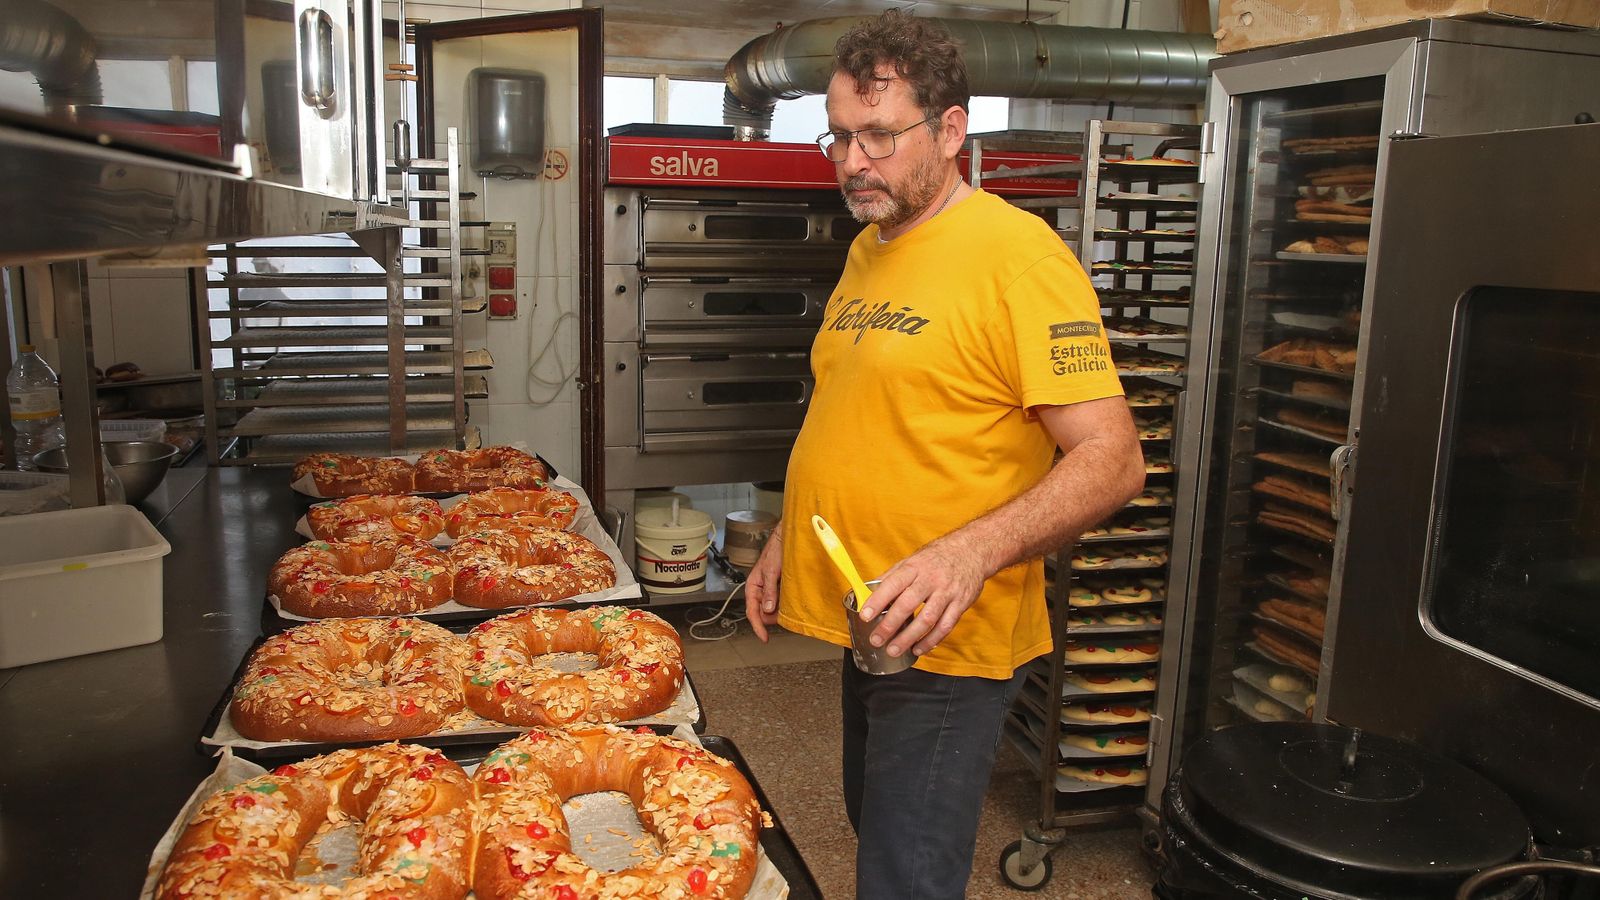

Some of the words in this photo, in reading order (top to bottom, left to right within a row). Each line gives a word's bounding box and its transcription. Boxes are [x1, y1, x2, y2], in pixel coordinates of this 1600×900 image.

[650, 151, 719, 176] salva
[828, 298, 930, 345] Tarifeña
[1050, 343, 1107, 360] Estrella
[1053, 357, 1108, 375] Galicia
